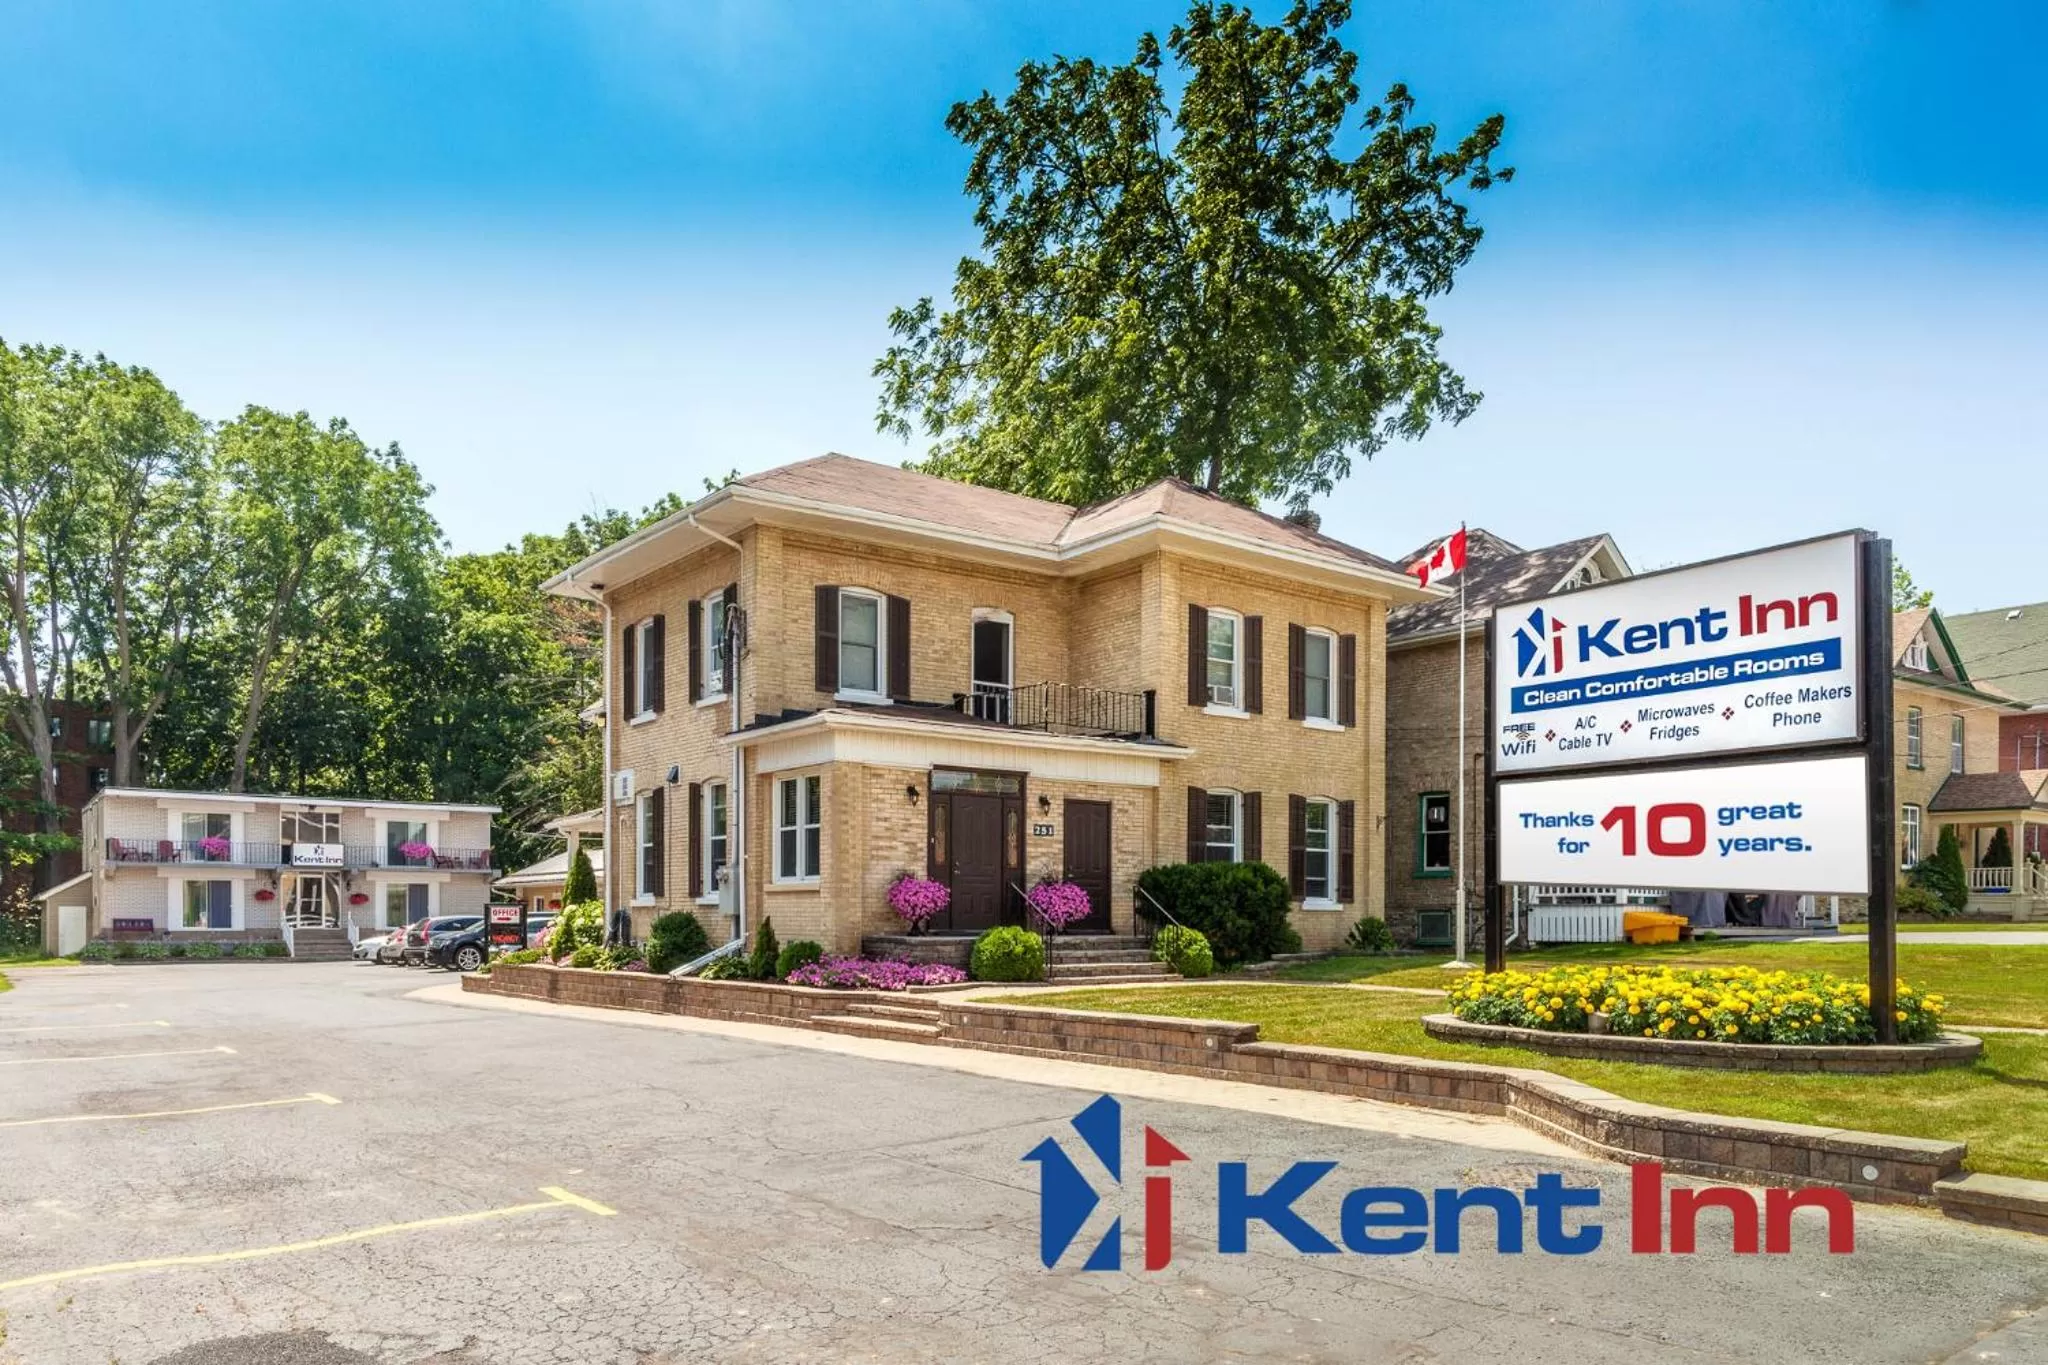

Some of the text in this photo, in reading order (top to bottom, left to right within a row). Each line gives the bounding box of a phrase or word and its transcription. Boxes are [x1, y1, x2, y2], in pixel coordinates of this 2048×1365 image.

[1578, 591, 1838, 662] Kent Inn
[1523, 652, 1825, 707] Clean Comfortable Rooms
[1744, 685, 1852, 709] Coffee Makers
[1637, 702, 1715, 722] Microwaves
[1772, 711, 1822, 727] Phone
[1502, 722, 1536, 733] FREE
[1575, 715, 1597, 730] A/C
[1558, 732, 1613, 751] Cable TV
[1650, 725, 1700, 742] Fridges
[1501, 740, 1536, 756] Wifi
[1519, 812, 1595, 829] Thanks
[1717, 801, 1803, 826] great
[1034, 825, 1053, 835] 251
[1600, 802, 1707, 857] 10
[1558, 837, 1590, 854] for
[1717, 835, 1812, 857] years.
[294, 855, 324, 864] Kent
[492, 909, 518, 917] OFFICE
